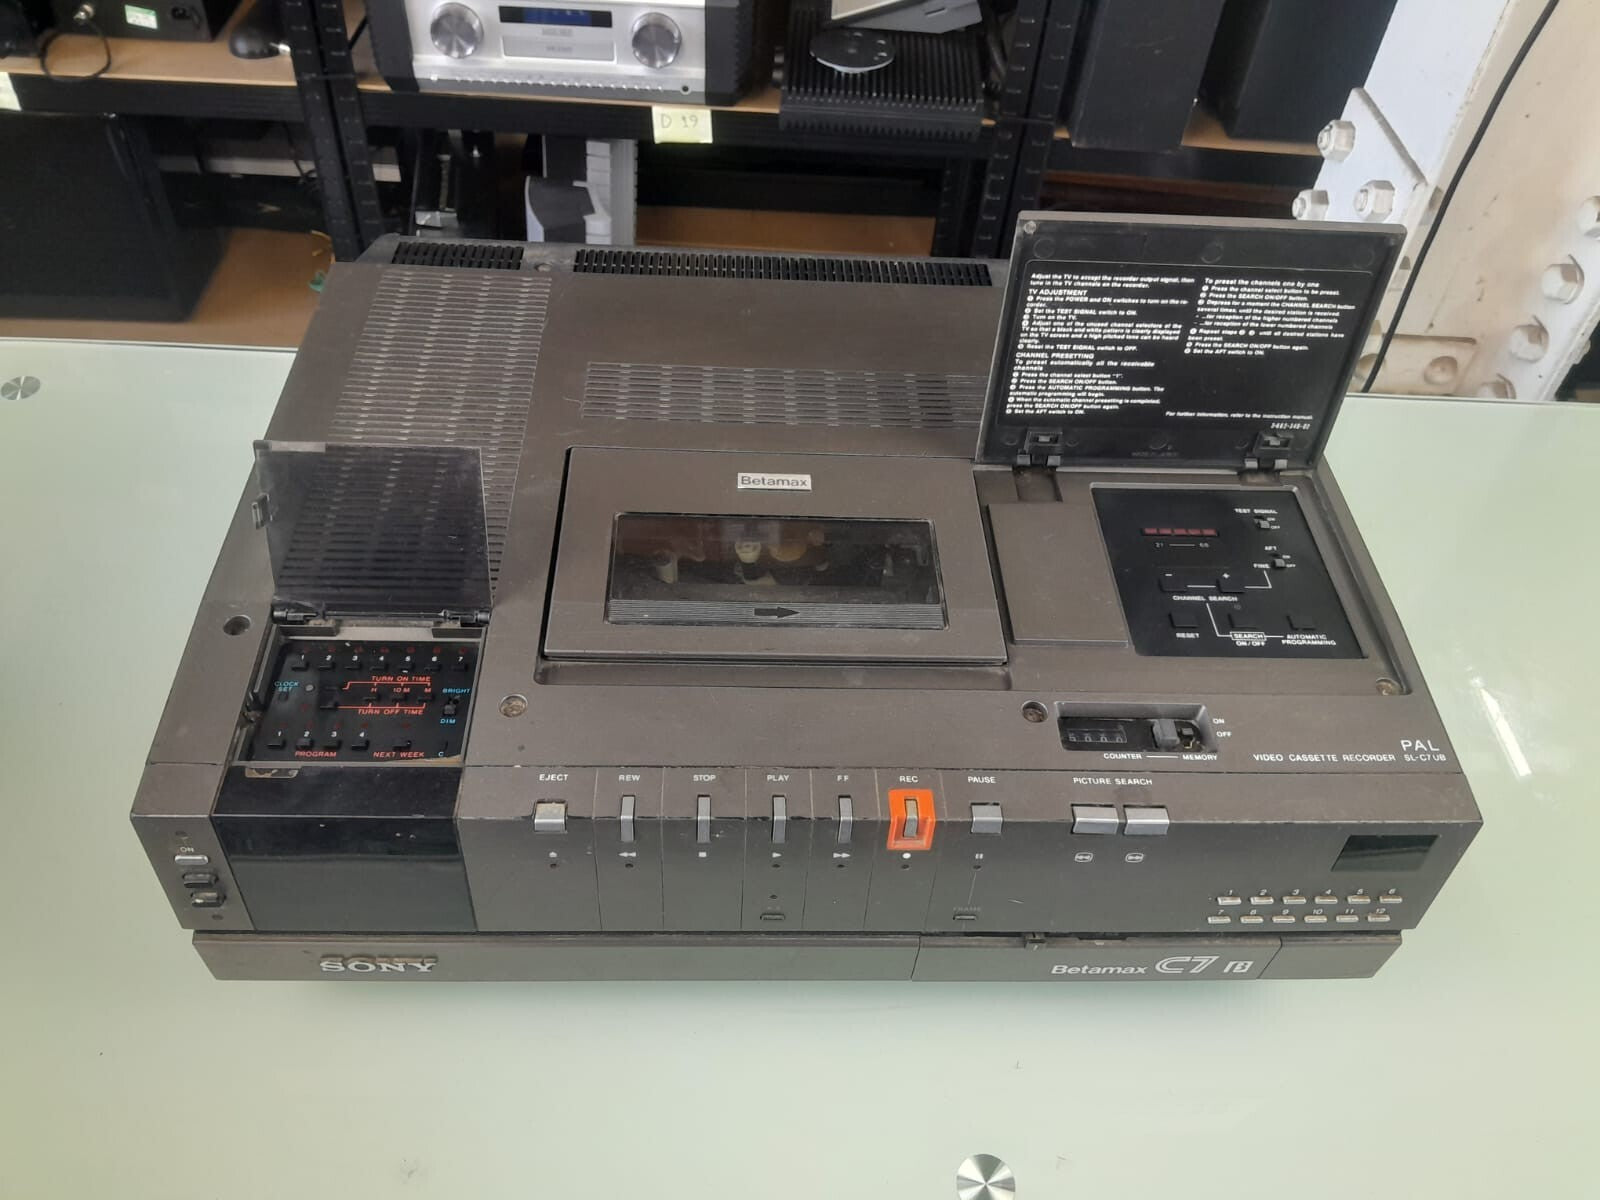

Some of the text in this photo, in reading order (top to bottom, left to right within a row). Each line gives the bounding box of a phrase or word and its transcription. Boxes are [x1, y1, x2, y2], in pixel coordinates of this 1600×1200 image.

[661, 114, 698, 129] D 19
[741, 476, 808, 486] Betamax
[1400, 740, 1440, 752] PAL
[320, 958, 438, 972] SONY
[1051, 956, 1220, 975] Betamax C7
